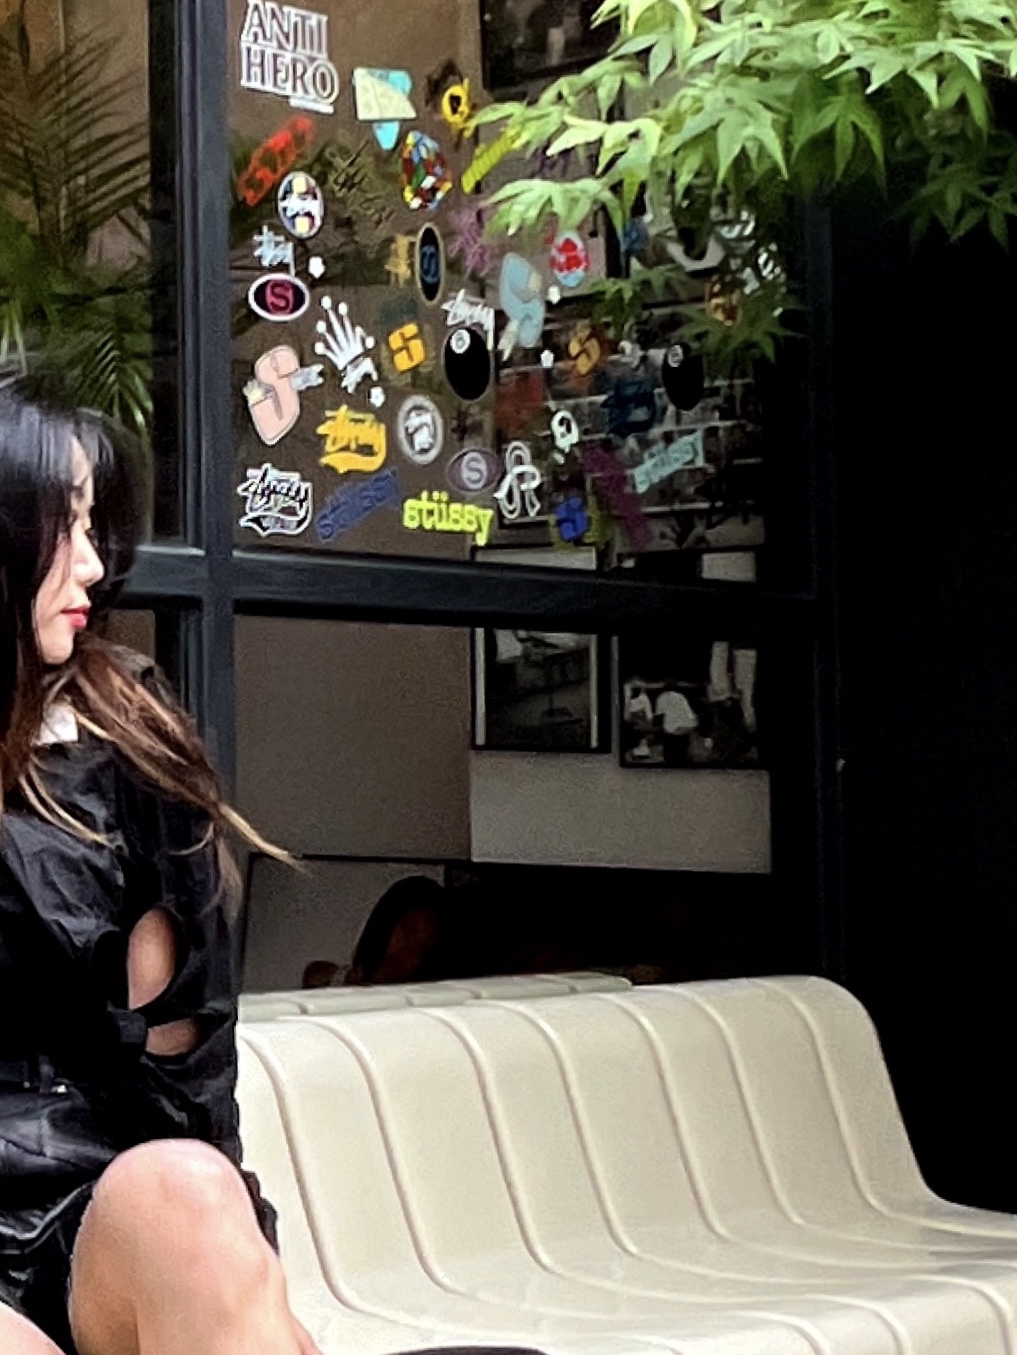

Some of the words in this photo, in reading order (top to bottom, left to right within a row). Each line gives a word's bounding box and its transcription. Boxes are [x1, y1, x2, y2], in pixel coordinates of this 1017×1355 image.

[242, 0, 327, 58] ANTI
[241, 44, 339, 104] HERO
[403, 489, 493, 546] stüssy
